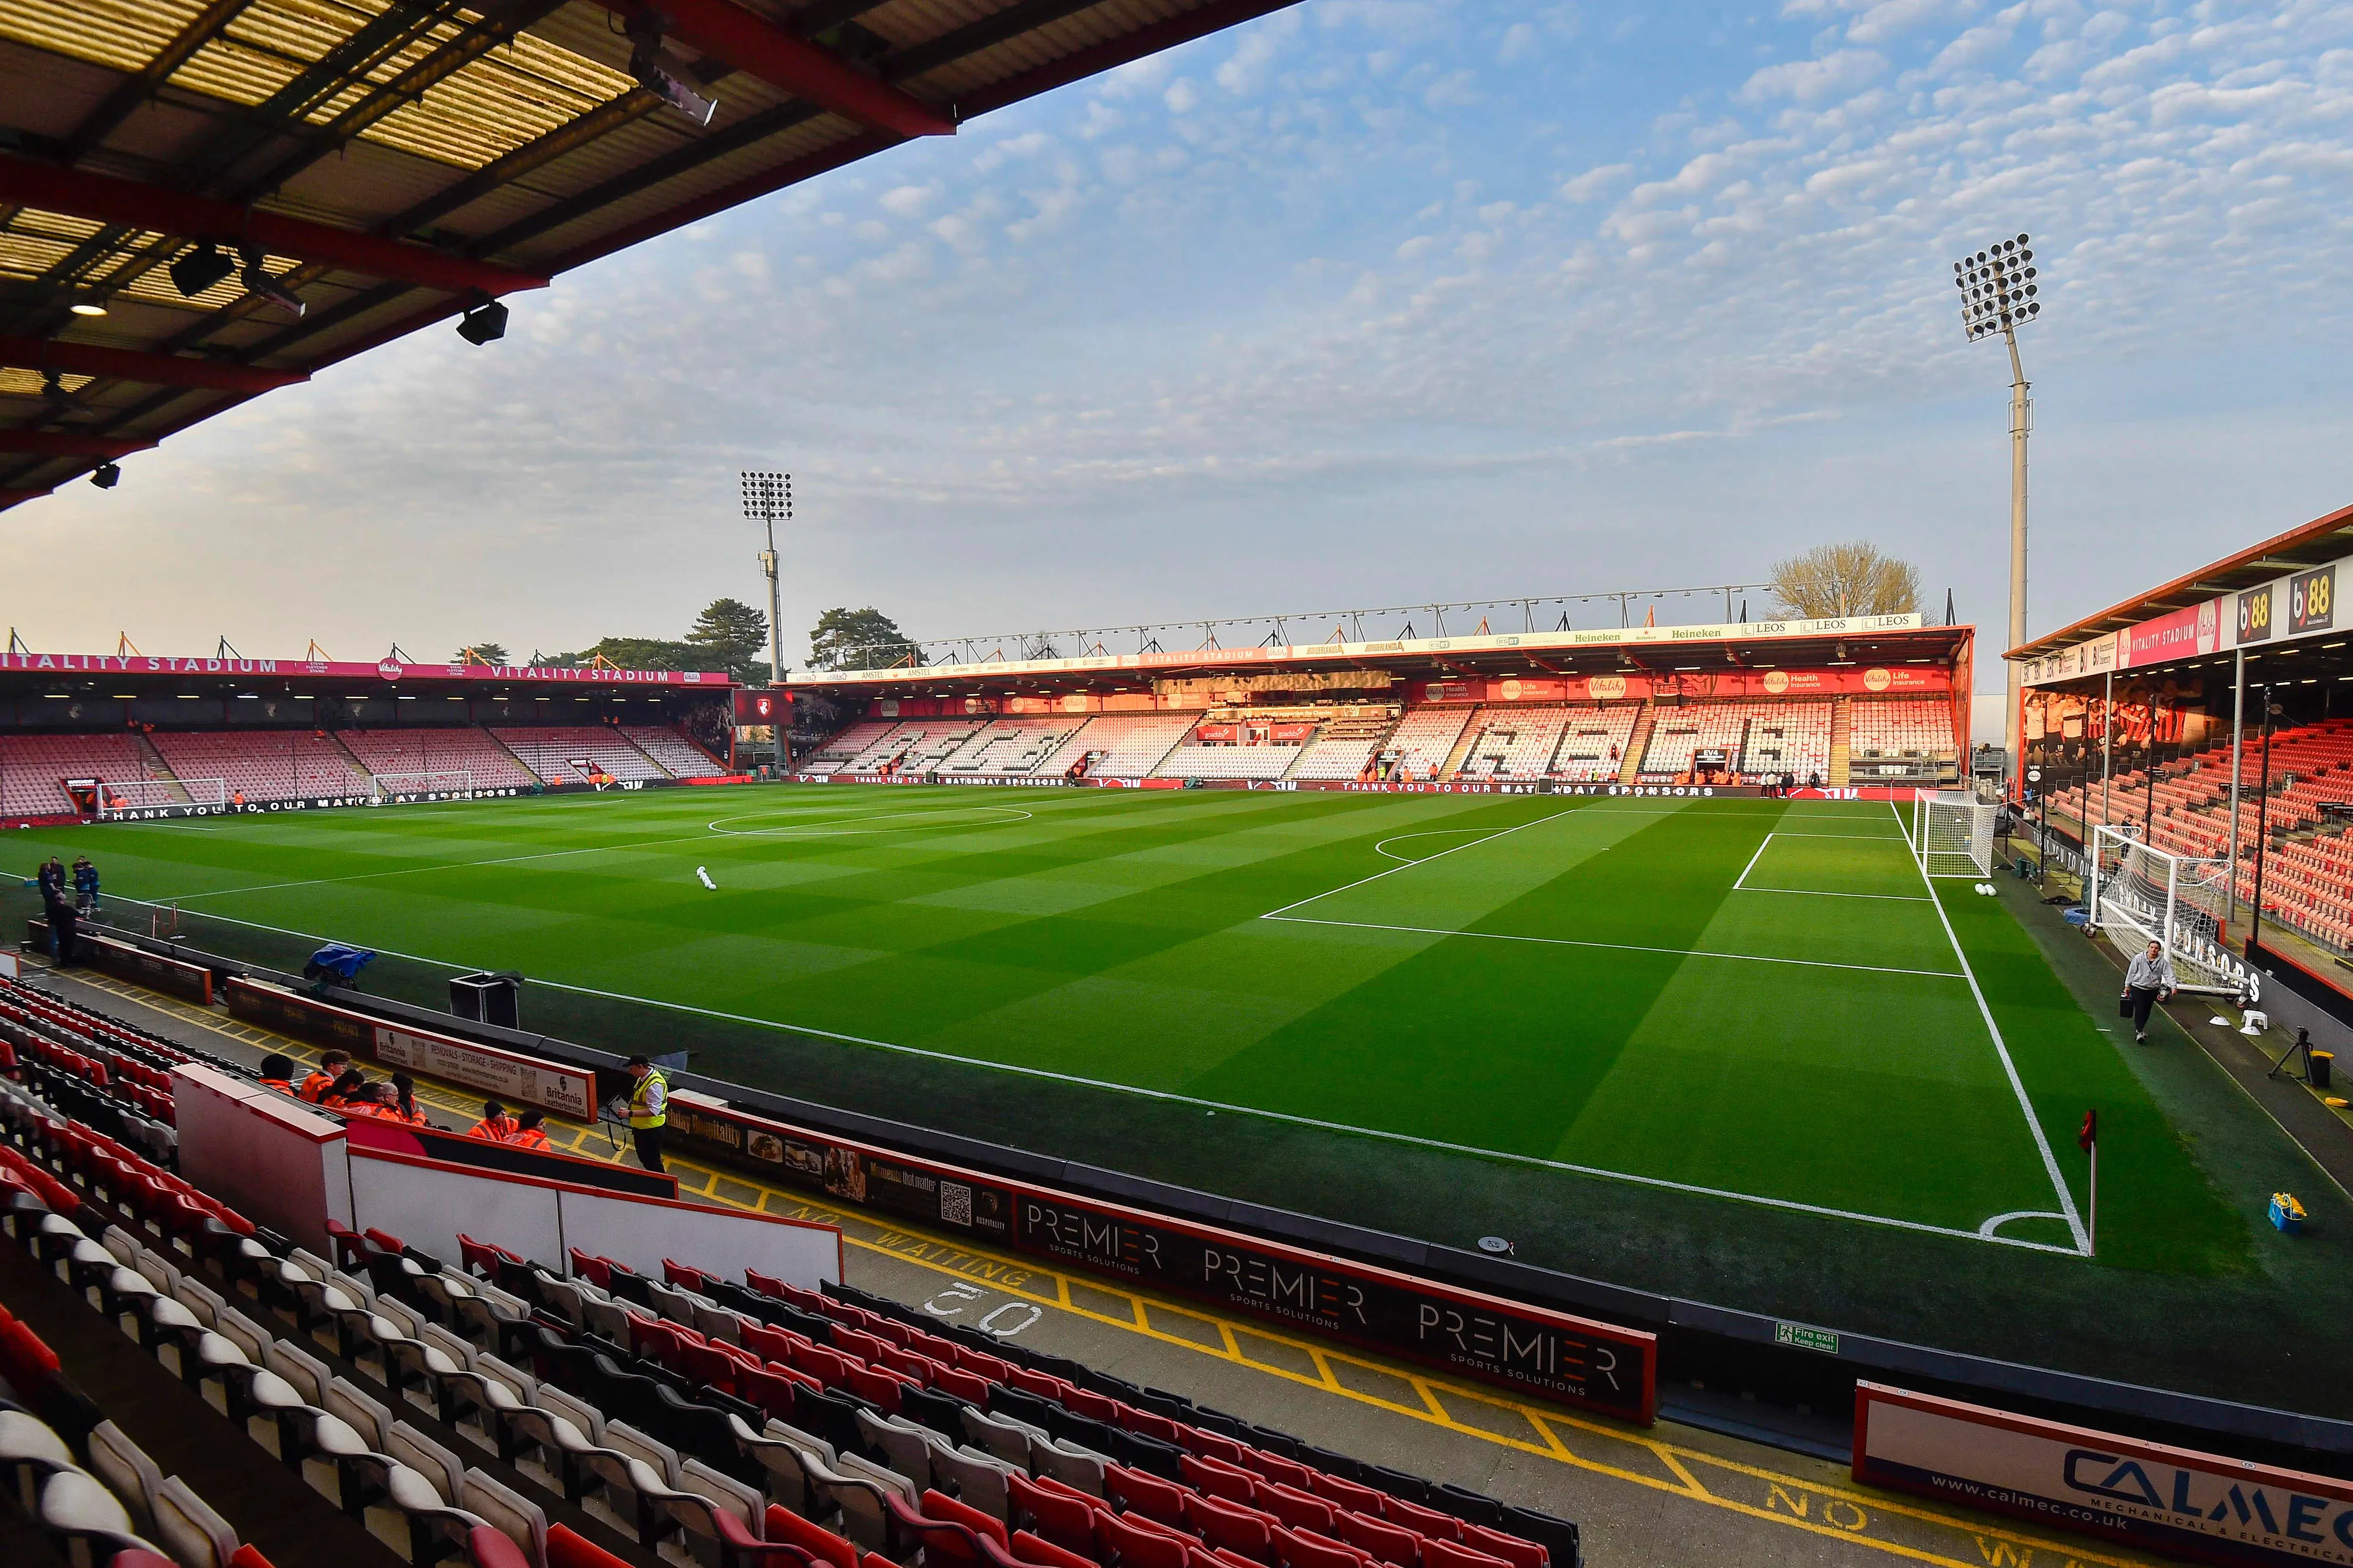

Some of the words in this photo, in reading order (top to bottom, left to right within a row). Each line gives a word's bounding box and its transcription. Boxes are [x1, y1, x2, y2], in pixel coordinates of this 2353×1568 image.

[2294, 575, 2329, 626] bj88
[1878, 616, 1909, 626] LEOS
[2240, 593, 2268, 638] bj88
[1672, 628, 1721, 638] Heineken
[1756, 623, 1785, 633] LEOS
[1816, 620, 1846, 630] LEOS
[1575, 633, 1621, 642] Heineken
[2132, 633, 2159, 652] VITALITY
[2162, 623, 2194, 646] STADIUM
[1307, 646, 1338, 655] BORDERLANDS
[1365, 642, 1398, 652] BORDERLANDS
[148, 656, 277, 673] STADIUM
[1148, 653, 1196, 663] VITALITY
[1204, 651, 1253, 660] STADIUM
[379, 663, 403, 675] Vitality
[491, 666, 583, 679] VITALITY
[591, 669, 668, 682] STADIUM
[907, 669, 931, 677] AMSTEL
[1591, 679, 1625, 694] Vitality
[1765, 677, 1788, 687] Vitality
[1865, 674, 1889, 684] Vitality
[1502, 685, 1521, 694] Vitality
[1205, 729, 1225, 739] goadsby
[1278, 729, 1299, 739] goadsby
[1006, 778, 1064, 786] SPONSORS
[1343, 782, 1388, 791] THANK
[1398, 783, 1425, 792] YOU
[1435, 783, 1451, 792] TO
[1461, 784, 1491, 793] OUR
[1501, 785, 1597, 795] MATHDAY
[1608, 786, 1713, 796] SPONSORS
[236, 803, 257, 813] TO
[270, 800, 306, 810] OUR
[428, 788, 516, 802] SPONSORS
[2164, 914, 2260, 1002] PONSORS
[379, 1042, 406, 1057] Britannia
[431, 1045, 458, 1059] REMOVALS
[462, 1052, 486, 1067] STORAGE
[491, 1060, 517, 1075] SHIPPING
[546, 1086, 582, 1105] Britannia
[545, 1098, 585, 1115] Leatherbarrows
[903, 1169, 915, 1187] that
[915, 1176, 936, 1193] matter
[976, 1216, 1005, 1230] HOSPITALITY
[1028, 1205, 1162, 1269] PREMIER
[876, 1230, 1032, 1286] WAITING
[1049, 1244, 1083, 1259] SPORTS
[1088, 1254, 1139, 1275] SOLUTIONS
[1205, 1249, 1367, 1325] PREMIER
[1230, 1293, 1270, 1311] SPORTS
[1276, 1306, 1339, 1330] SOLUTIONS
[1795, 1327, 1814, 1338] Fire
[1817, 1333, 1834, 1343] exit
[1795, 1336, 1814, 1347] Keep
[1815, 1342, 1834, 1350] clear
[1419, 1303, 1619, 1390] PREMIER
[1451, 1353, 1500, 1373] SPORTS
[1507, 1368, 1585, 1396] SOLUTIONS
[1766, 1484, 1868, 1531] NO
[1931, 1474, 2129, 1530] www.calmec.co.uk
[2091, 1498, 2207, 1532] MECHANICAL
[2219, 1527, 2228, 1536] &
